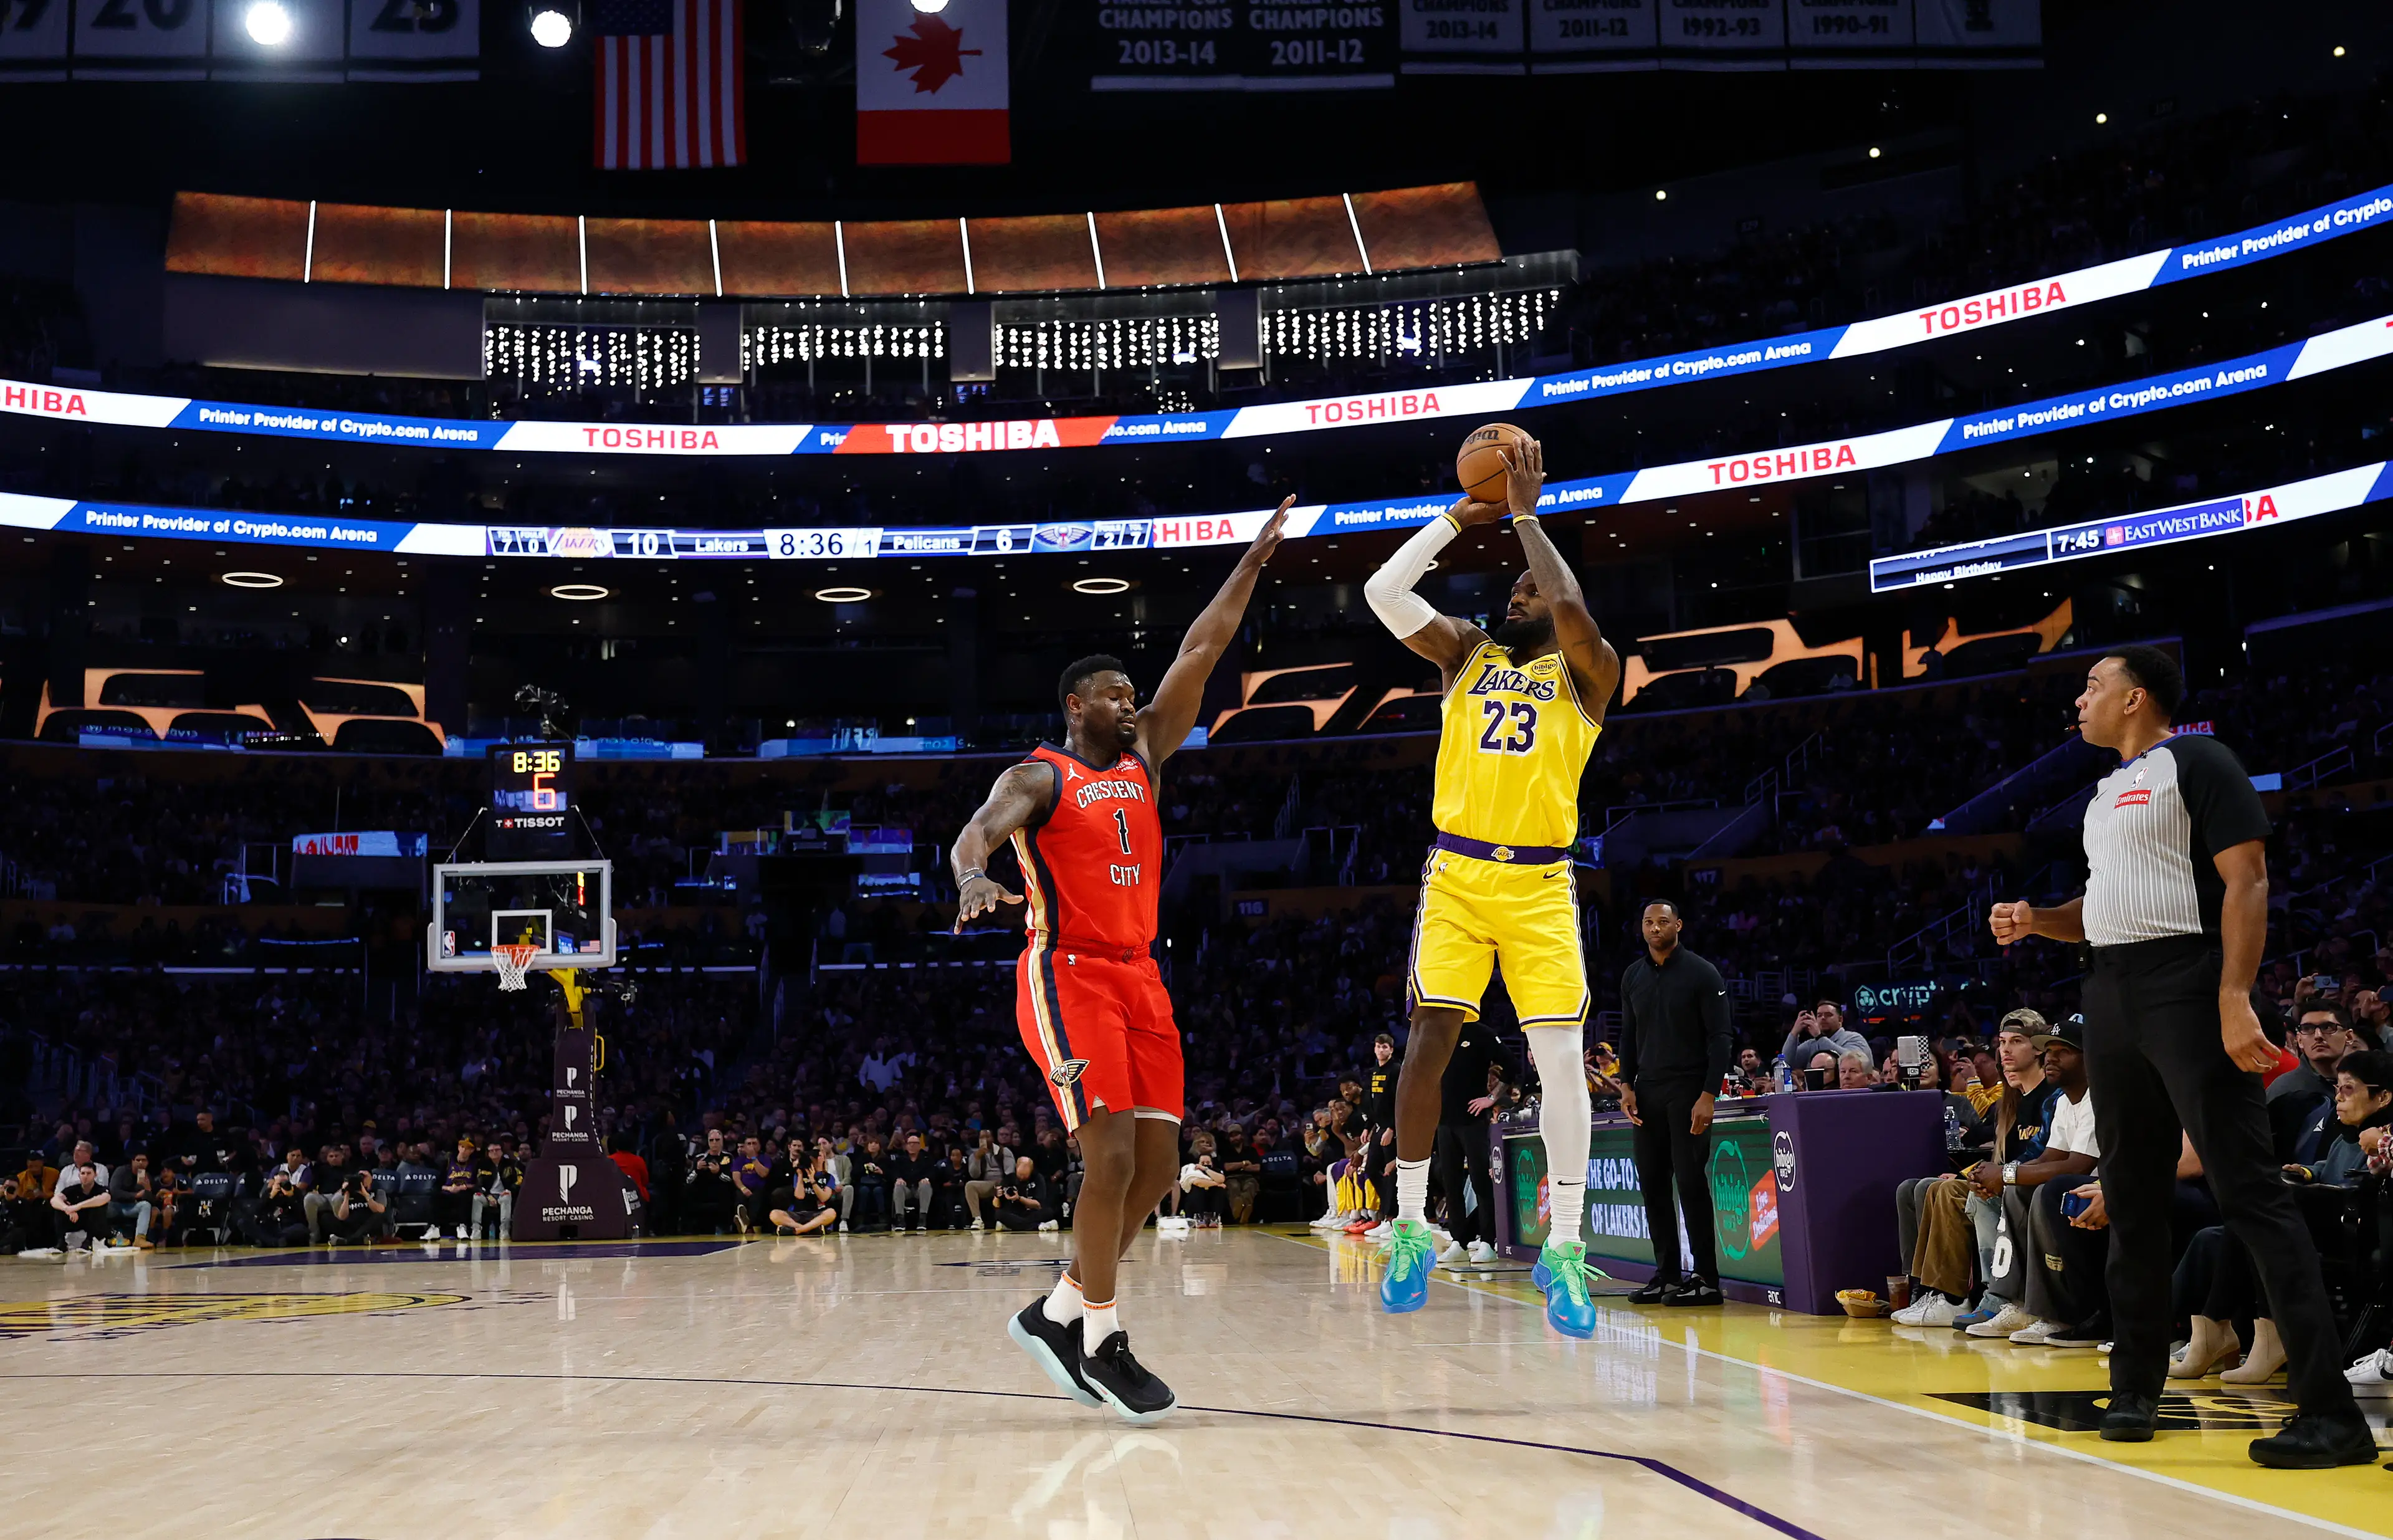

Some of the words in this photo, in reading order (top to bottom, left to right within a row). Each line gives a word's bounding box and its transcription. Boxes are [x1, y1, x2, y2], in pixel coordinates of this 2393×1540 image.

[1099, 8, 1233, 29] CHAMPIONS
[1248, 7, 1384, 30] CHAMPIONS
[1426, 20, 1497, 39] 2013-14
[1560, 18, 1629, 37] 2011-12
[1683, 17, 1760, 36] 1992-93
[1813, 16, 1888, 34] 1990-91
[1119, 40, 1217, 65] 2013-14
[1271, 39, 1365, 65] 2011-12
[2182, 246, 2238, 269] Printer
[2242, 224, 2309, 254] Provider
[2313, 214, 2330, 232] of
[1920, 282, 2066, 333] TOSHIBA
[1543, 380, 1589, 396] Printer
[1592, 369, 1651, 388] Provider
[1655, 363, 1669, 378] of
[1673, 352, 1761, 375] Crypto.com
[1765, 343, 1811, 360] Arena
[0, 386, 86, 415] HIBA
[1306, 393, 1440, 424] TOSHIBA
[1964, 418, 2014, 439] Printer
[2018, 404, 2085, 428] Provider
[2089, 396, 2105, 413] of
[2109, 378, 2211, 408] Crypto.com
[2215, 365, 2266, 387] Arena
[200, 409, 251, 424] Printer
[254, 413, 318, 430] Provider
[321, 419, 337, 431] of
[340, 419, 429, 438] Crypto.com
[432, 426, 477, 441] Arena
[886, 419, 1060, 452] TOSHIBA
[1162, 421, 1206, 434] Arena
[583, 428, 718, 449] TOSHIBA
[1708, 445, 1856, 484] TOSHIBA
[1559, 487, 1602, 504] Arena
[1335, 510, 1382, 525] Printer
[1384, 504, 1445, 522] Provider
[87, 511, 139, 527] Printer
[143, 515, 210, 532] Provider
[214, 520, 230, 533] of
[234, 520, 327, 538] Crypto.com
[330, 527, 376, 542] Arena
[502, 539, 513, 553] 7
[528, 539, 539, 553] 0
[627, 533, 659, 555] 10
[695, 537, 749, 553] Lakers
[780, 533, 844, 556] 8:36
[864, 540, 871, 555] 1
[893, 535, 960, 550] Pelicans
[996, 528, 1013, 551] 6
[1104, 532, 1115, 547] 2
[1130, 531, 1142, 547] 7
[2057, 530, 2099, 552] 7:45
[1954, 560, 2002, 578] Birthday
[1468, 663, 1557, 702] LAKERS
[1478, 700, 1538, 757] 23
[513, 750, 560, 773] 8:36
[533, 772, 556, 810] 6
[1076, 780, 1145, 809] CRESCENT
[2115, 793, 2149, 807] Emirates
[514, 816, 565, 828] TISSOT
[1113, 808, 1132, 855] 1
[1109, 863, 1140, 887] CITY
[1776, 1147, 1794, 1175] bibigo
[1587, 1159, 1603, 1190] THE
[1603, 1157, 1634, 1191] GO-TO
[542, 1205, 593, 1216] PECHANGA
[1715, 1173, 1748, 1225] bibigo
[1755, 1191, 1769, 1213] Live
[1591, 1203, 1604, 1235] OF
[1604, 1203, 1641, 1239] LAKERS
